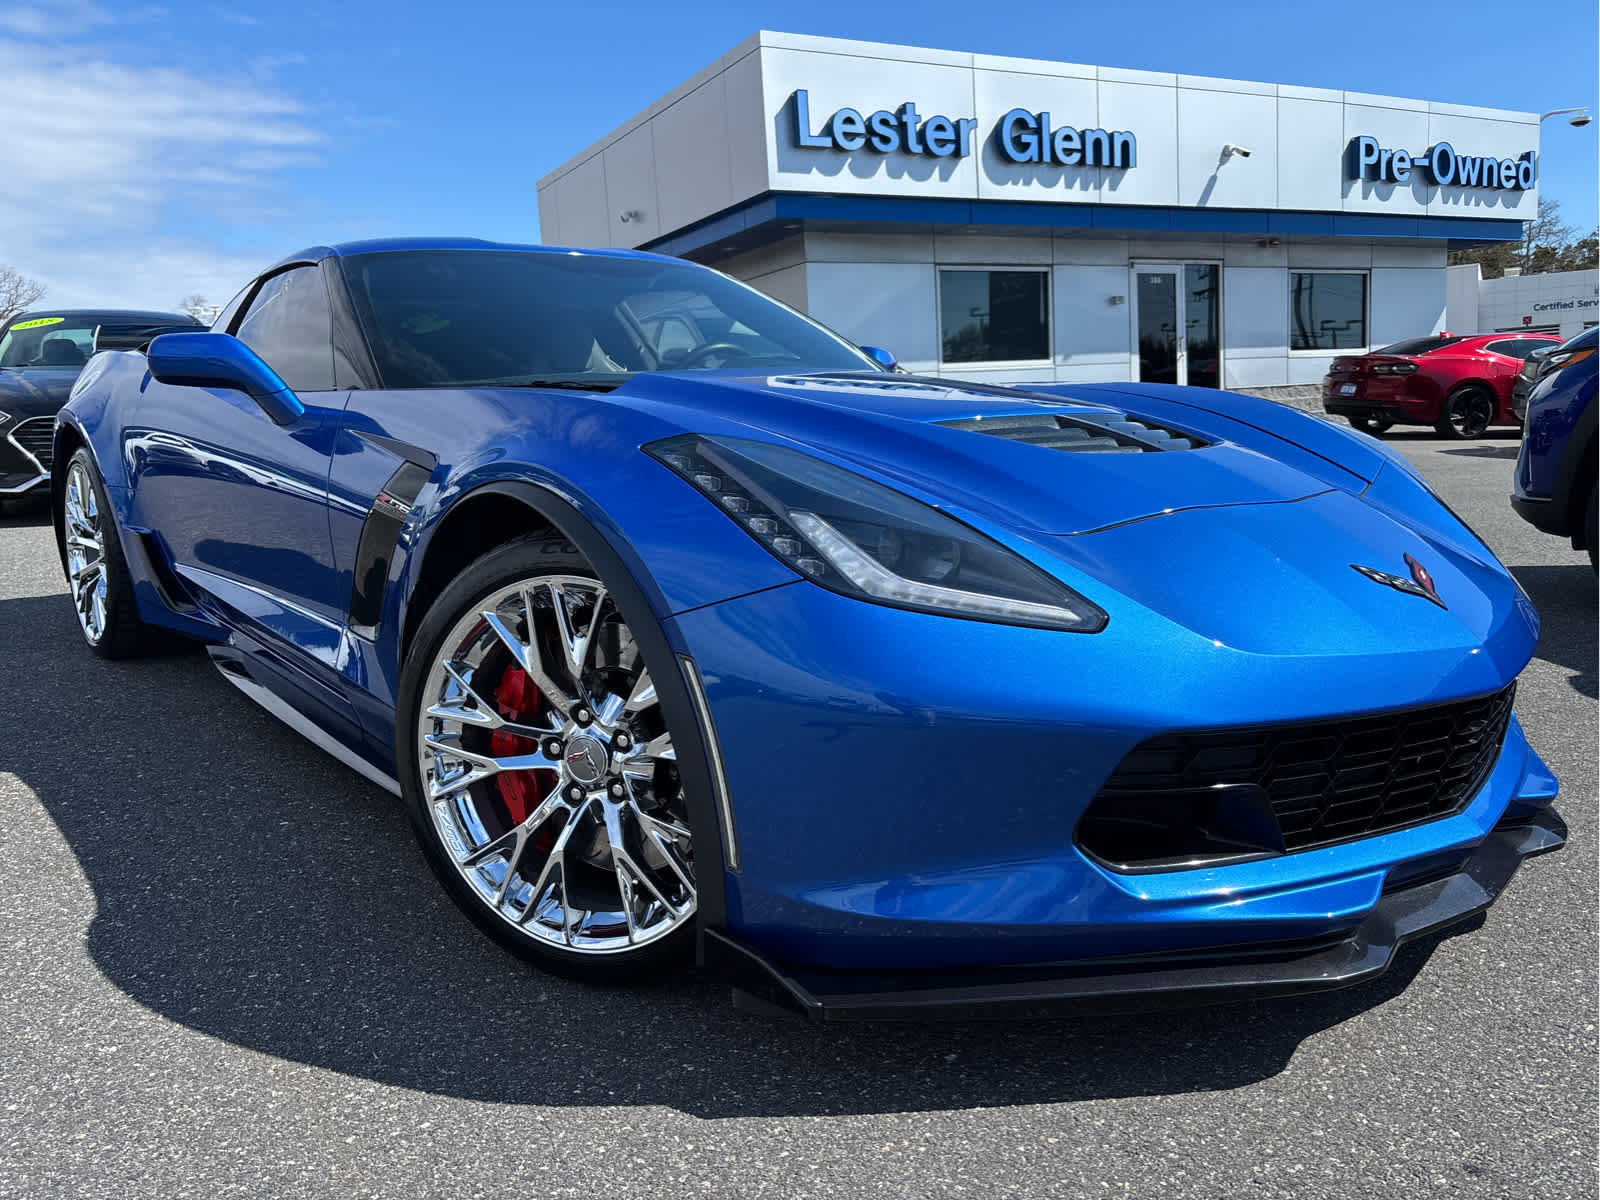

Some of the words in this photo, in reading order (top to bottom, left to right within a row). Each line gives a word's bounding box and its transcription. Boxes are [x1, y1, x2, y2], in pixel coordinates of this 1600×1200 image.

[795, 89, 978, 158] Lester
[1000, 108, 1138, 169] Glenn
[1357, 135, 1536, 190] Pre-Owned
[1533, 302, 1574, 311] Certified
